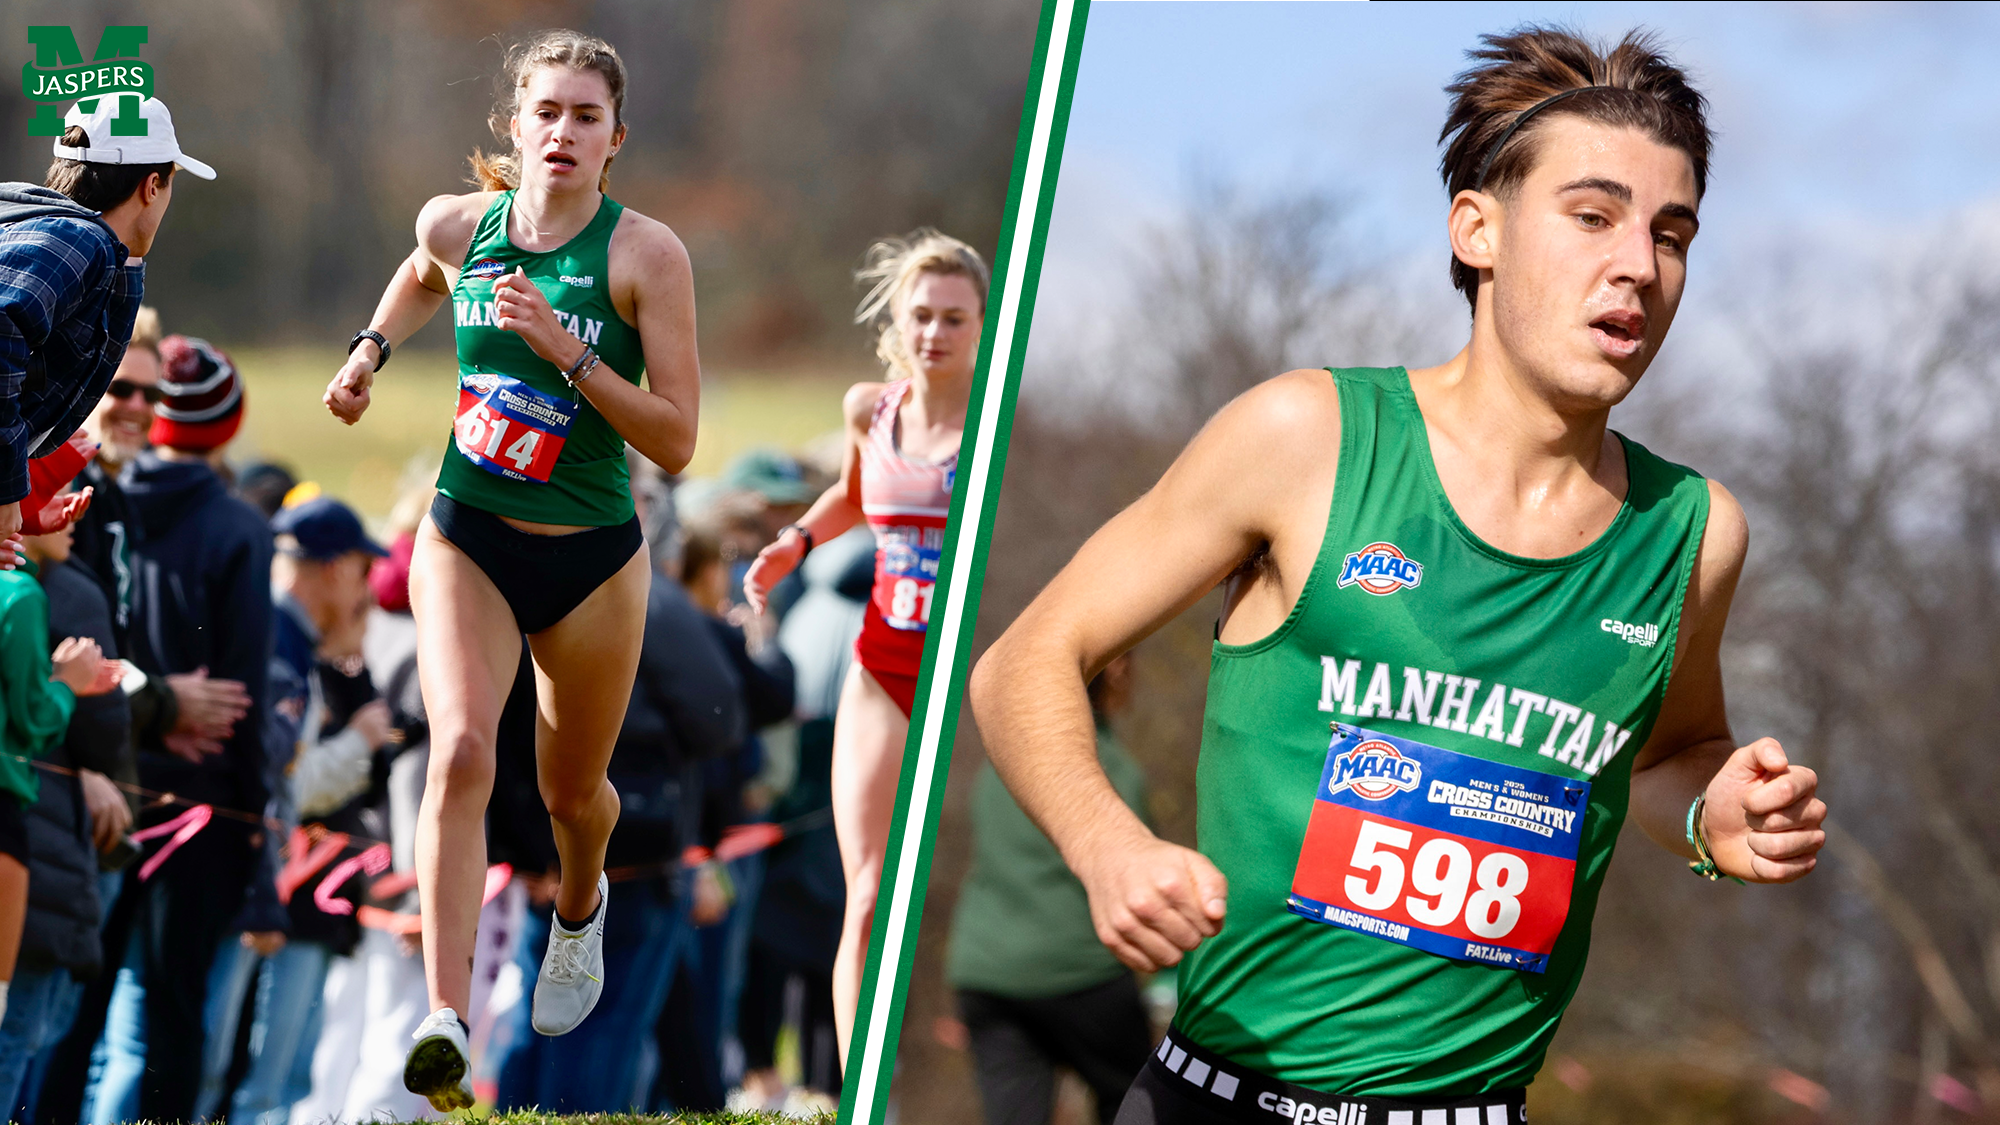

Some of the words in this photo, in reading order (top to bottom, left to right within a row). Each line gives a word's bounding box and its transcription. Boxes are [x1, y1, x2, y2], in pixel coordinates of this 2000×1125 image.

[559, 275, 594, 286] capelli
[456, 301, 603, 345] MANTAN
[498, 388, 528, 409] CROSS
[527, 402, 571, 426] COUNTRY
[460, 404, 541, 471] 614
[1341, 554, 1417, 583] MAAC
[1600, 618, 1659, 642] capelli
[1626, 636, 1656, 648] SPORT
[1317, 655, 1632, 777] MANHATTAN
[1333, 753, 1416, 786] MAAC
[1503, 779, 1525, 790] 2025
[1469, 778, 1500, 792] MEN'S
[1501, 787, 1508, 795] &
[1427, 779, 1494, 810] CROSS
[1494, 794, 1576, 834] COUNTRY
[1455, 807, 1550, 835] CHAMPIONSHIPS
[1343, 819, 1529, 939] 598
[1324, 905, 1410, 942] MAACSPORTS.COM
[1465, 943, 1512, 963] FAT.Live
[1257, 1091, 1368, 1125] capelli
